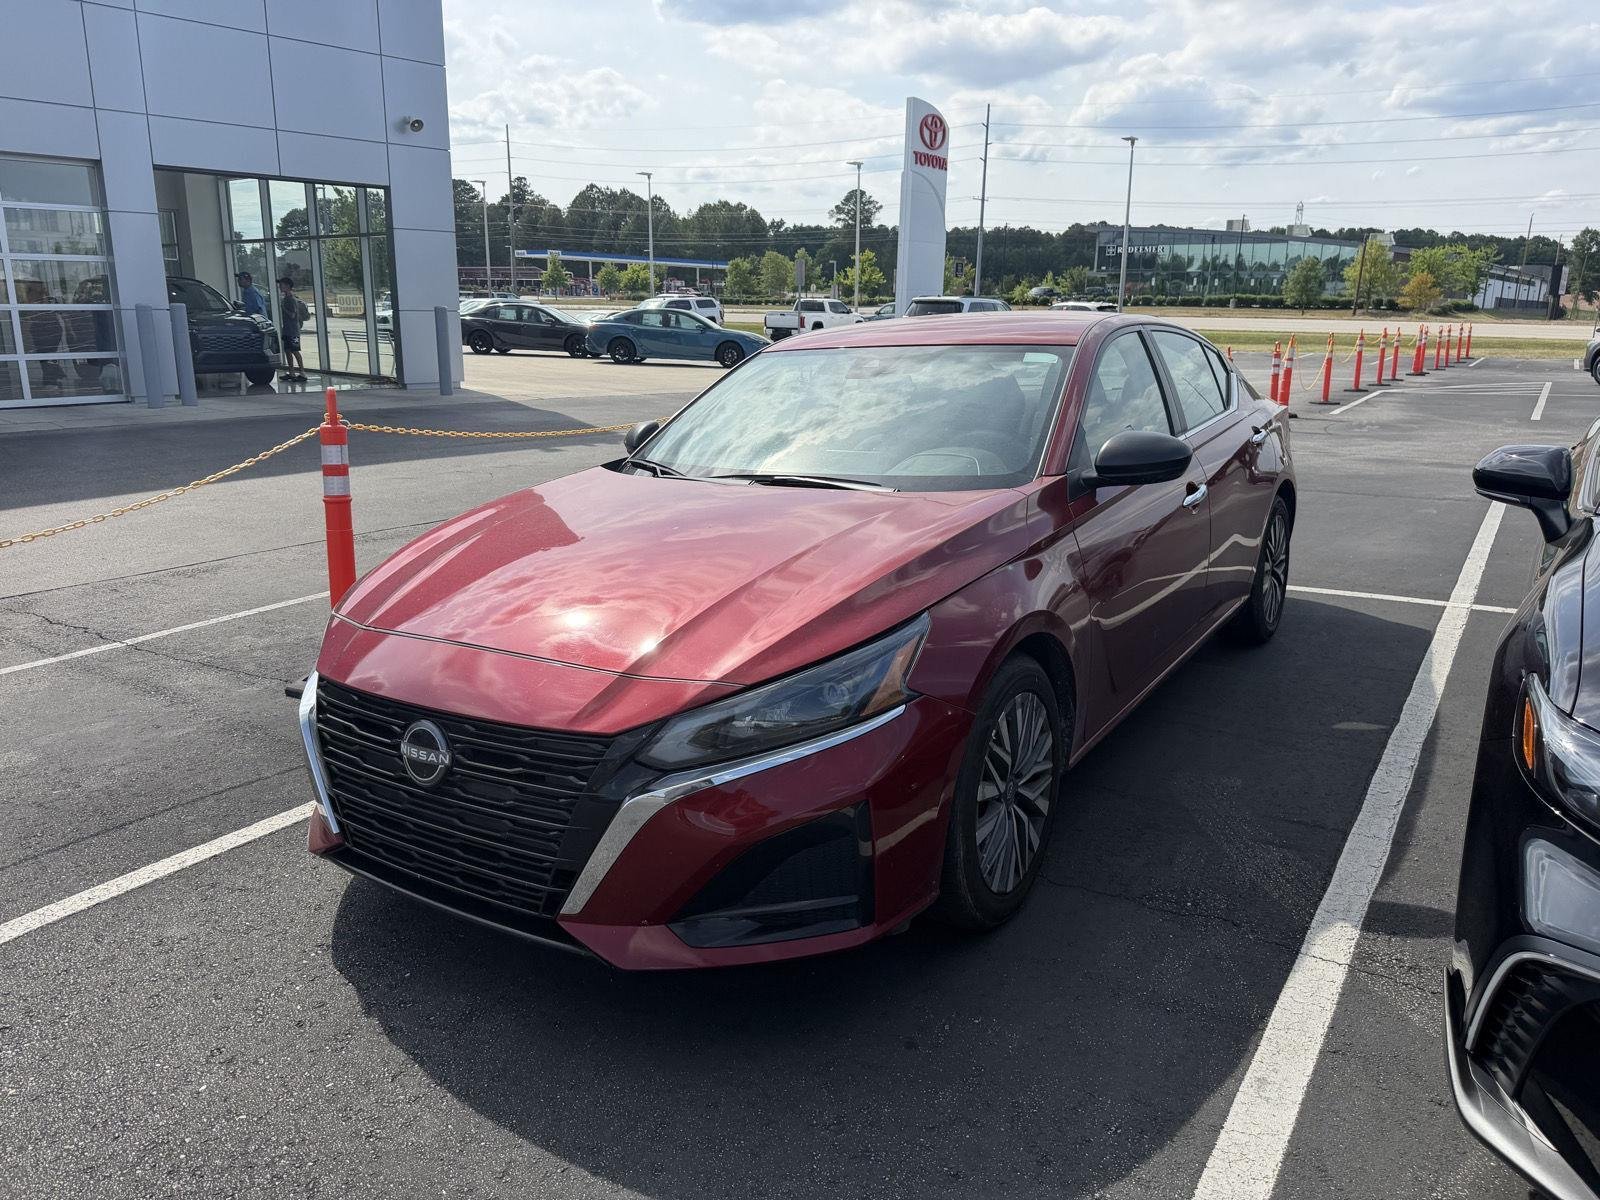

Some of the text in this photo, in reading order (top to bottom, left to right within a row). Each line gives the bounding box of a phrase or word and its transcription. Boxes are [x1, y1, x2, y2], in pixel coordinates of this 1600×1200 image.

[913, 150, 948, 171] TOYOTA
[1117, 245, 1164, 254] RDEEMER
[401, 743, 449, 763] NISSAN
